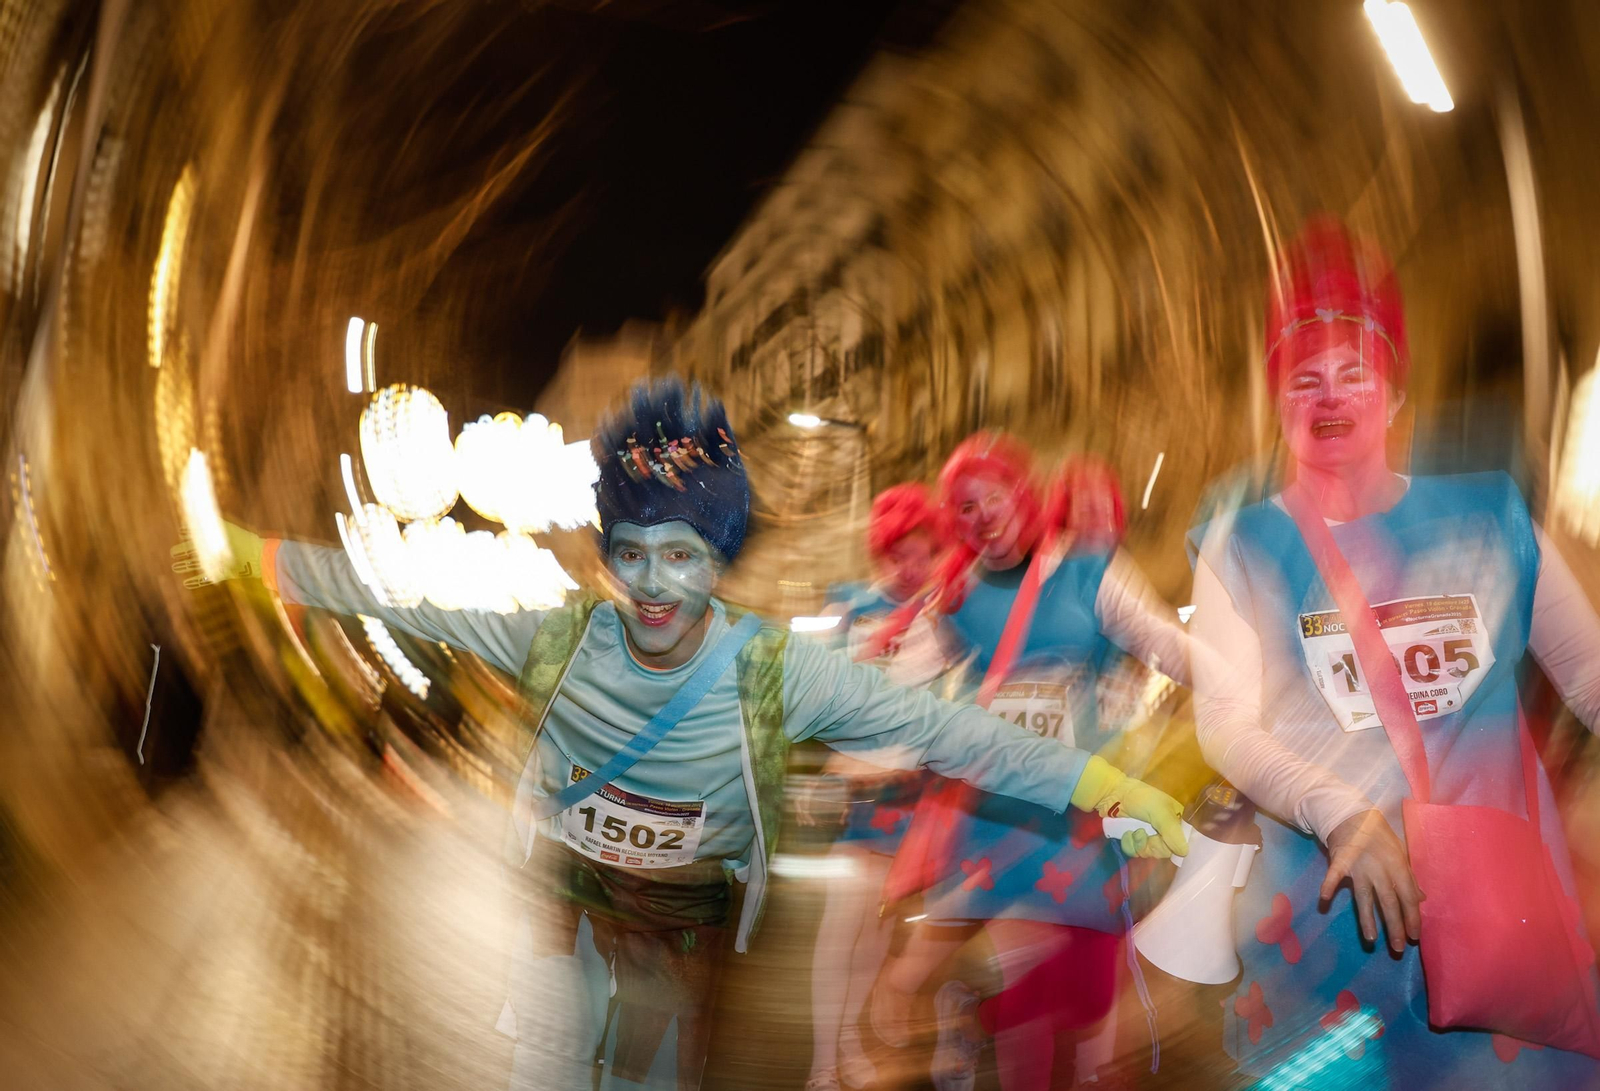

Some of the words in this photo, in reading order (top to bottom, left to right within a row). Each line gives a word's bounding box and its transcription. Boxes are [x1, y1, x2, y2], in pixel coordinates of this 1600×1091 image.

[1304, 616, 1323, 636] 33
[1331, 639, 1480, 692] 105
[1408, 690, 1430, 700] EDINA
[1430, 687, 1449, 698] COBO
[596, 788, 626, 806] TURNA
[578, 806, 686, 850] 1502
[585, 835, 602, 848] RAFAEL
